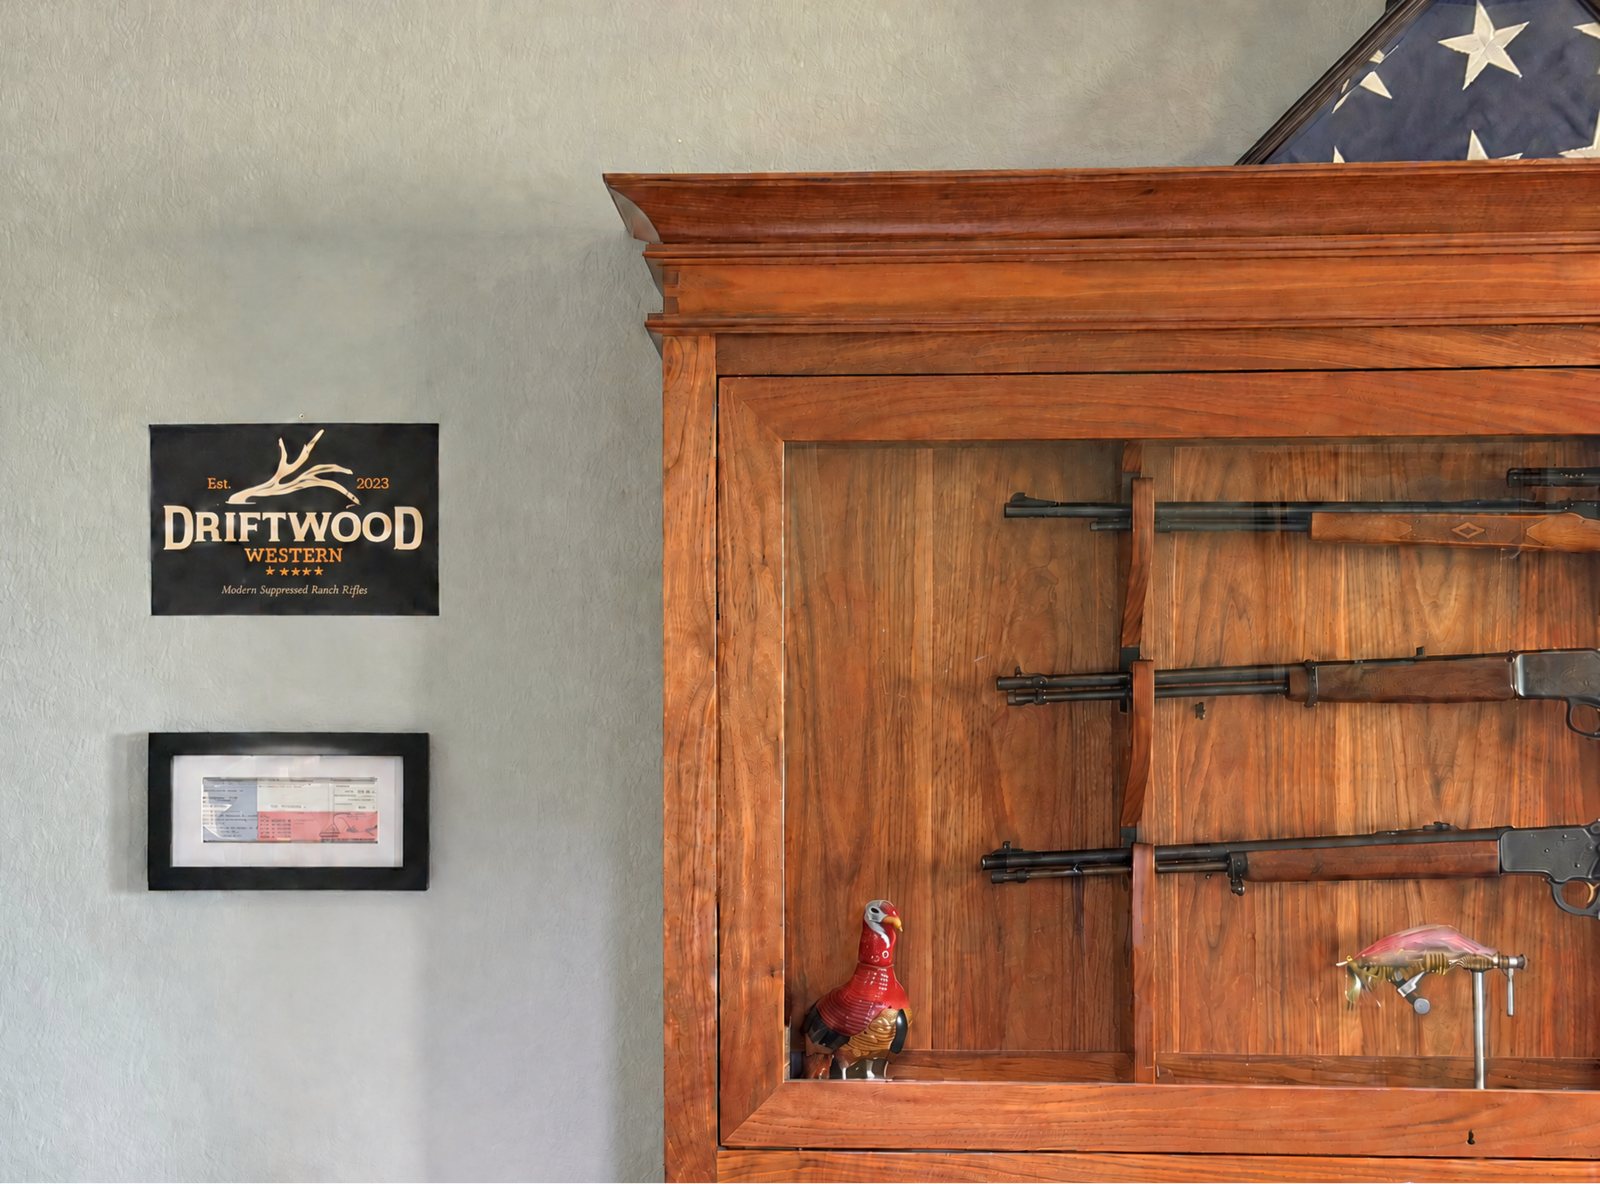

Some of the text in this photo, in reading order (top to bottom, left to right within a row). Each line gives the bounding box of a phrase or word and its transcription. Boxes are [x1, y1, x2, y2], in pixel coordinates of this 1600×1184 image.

[207, 477, 390, 490] Est. 2023
[163, 505, 424, 551] DRIFTWOOD
[244, 547, 343, 563] WESTERN
[221, 584, 368, 598] Modern Suppressed Ranch Rifles
